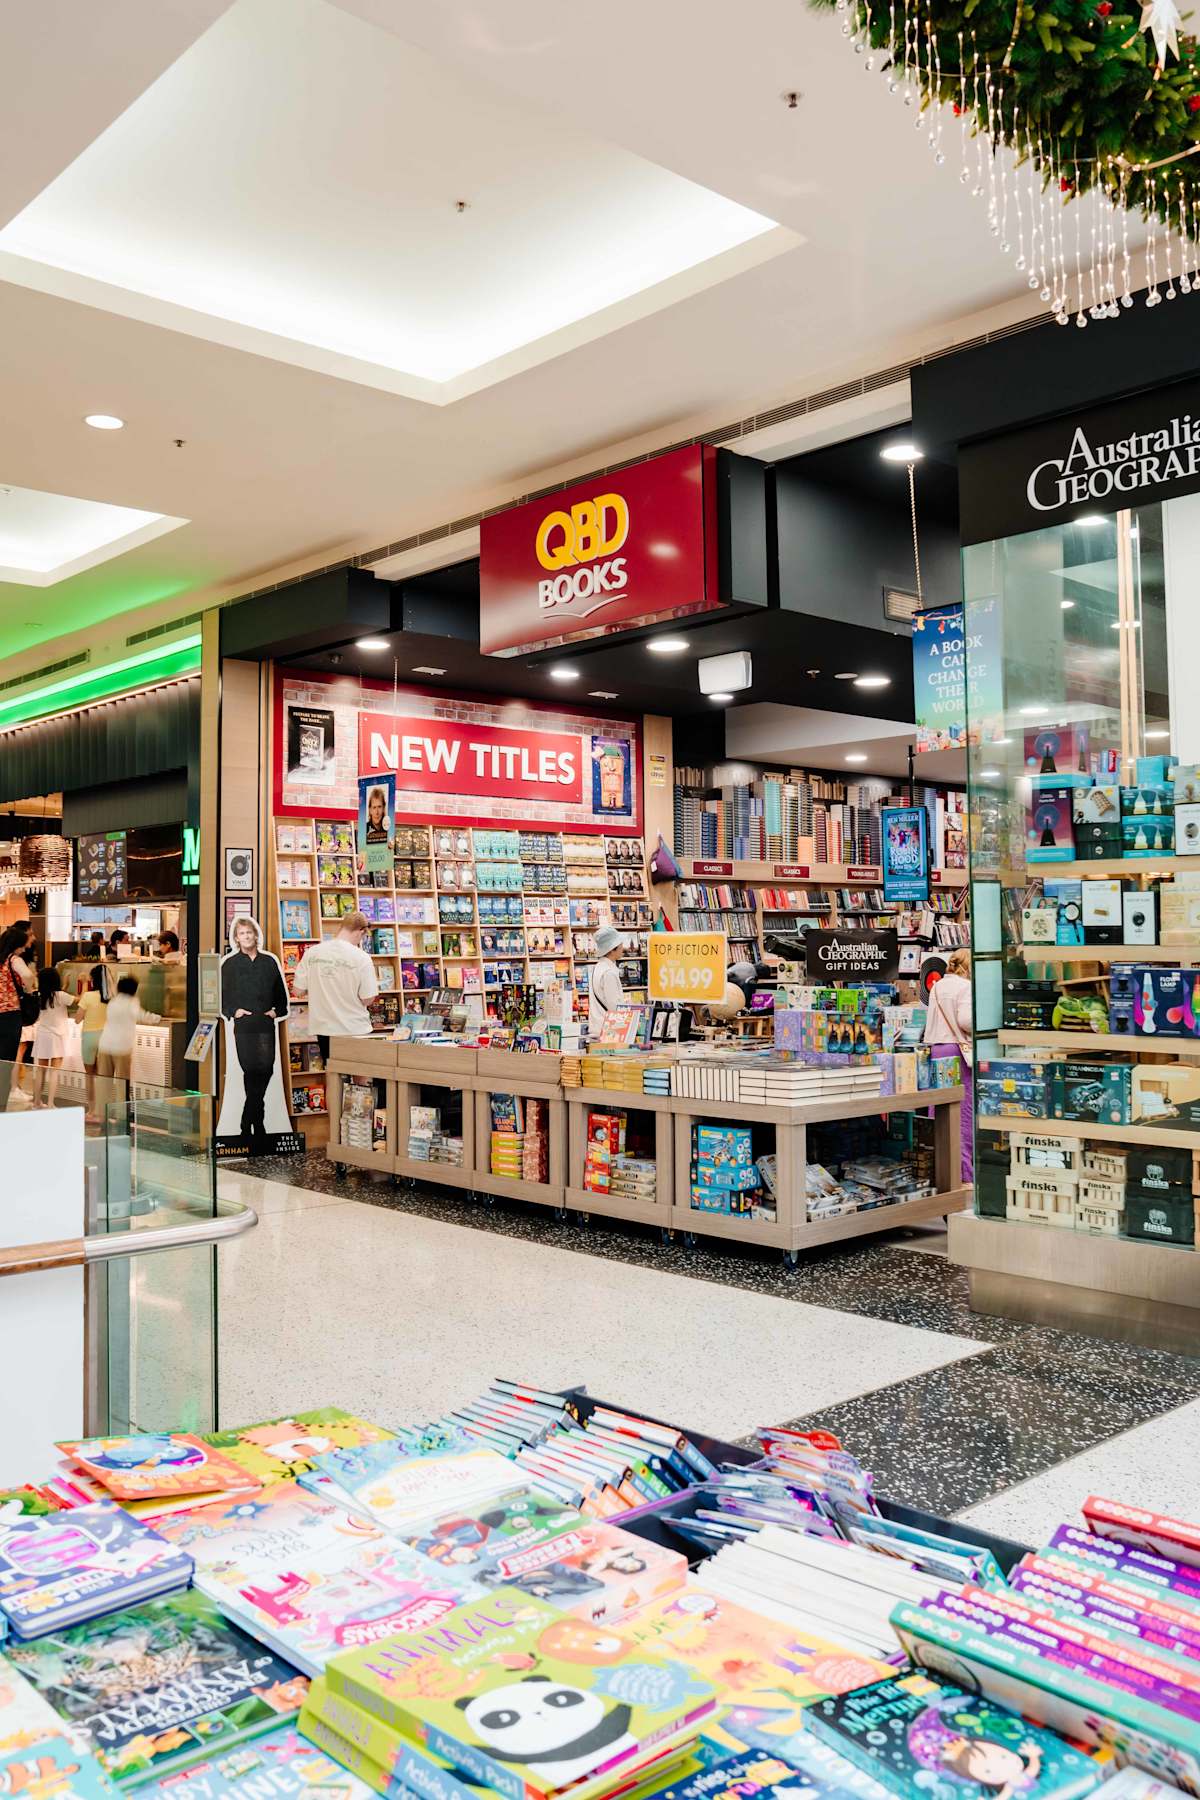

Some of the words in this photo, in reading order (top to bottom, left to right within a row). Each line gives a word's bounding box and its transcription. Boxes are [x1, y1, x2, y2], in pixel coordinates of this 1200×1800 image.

[535, 493, 630, 571] QBD
[538, 558, 628, 608] BOOKS
[930, 643, 939, 656] A
[942, 635, 983, 654] BOOK
[942, 653, 971, 668] CAN
[928, 665, 987, 685] CHANGE
[936, 681, 979, 698] THER
[932, 696, 985, 713] WORD
[370, 732, 461, 775] NEW
[469, 742, 576, 785] TITLES
[891, 855, 918, 865] HOOD
[654, 944, 672, 955] TOP
[675, 944, 719, 956] FICTION
[830, 937, 878, 951] Australian
[818, 945, 888, 960] GEOGRAPHIC
[826, 962, 847, 971] GIFT
[850, 962, 879, 971] IDEAS
[658, 963, 713, 992] $14.99
[995, 1072, 1027, 1080] OCEANS
[1025, 1136, 1062, 1147] finska
[1021, 1180, 1058, 1192] finska
[1142, 1178, 1169, 1188] finska
[342, 1600, 454, 1646] UNICORNS
